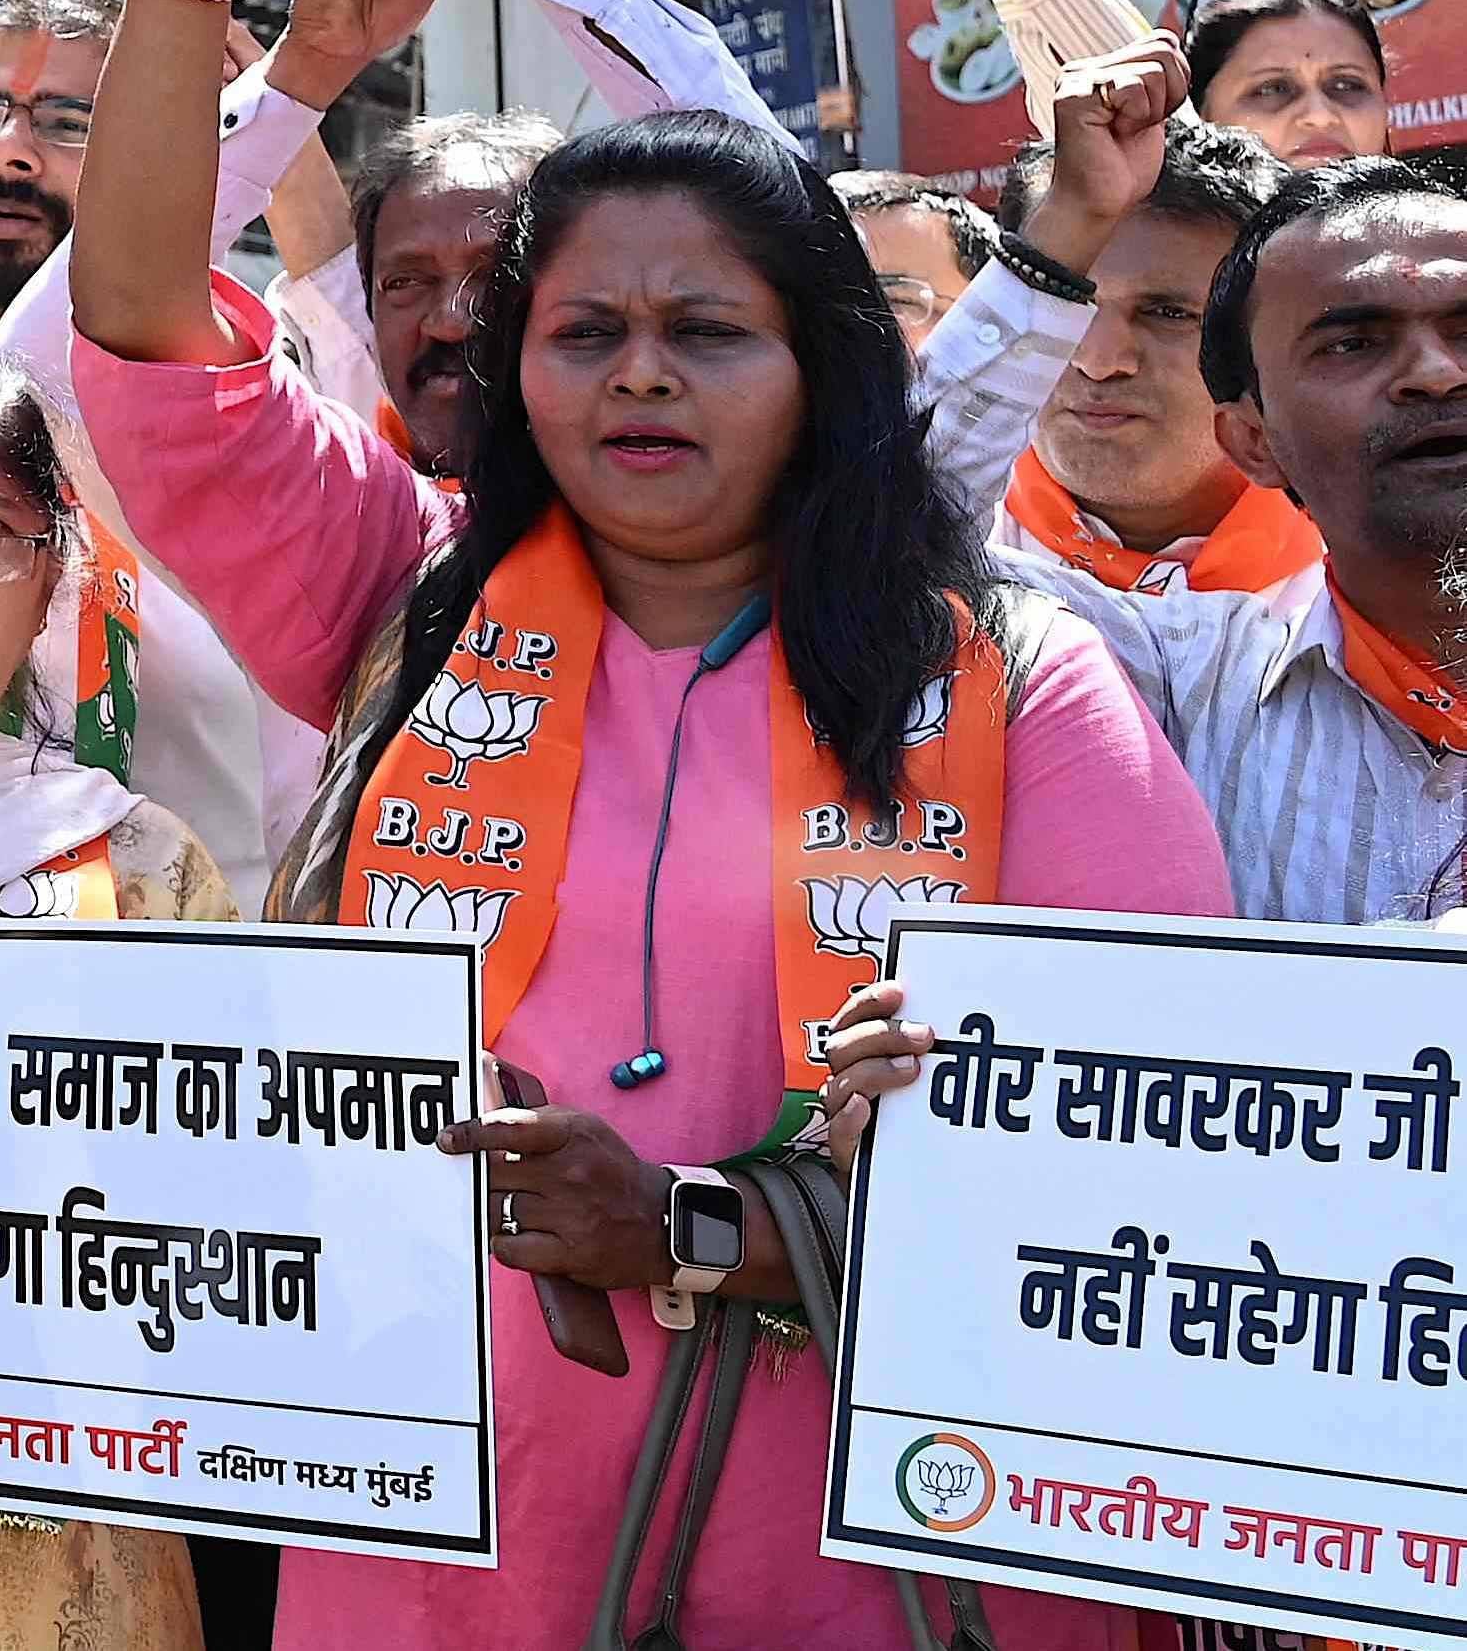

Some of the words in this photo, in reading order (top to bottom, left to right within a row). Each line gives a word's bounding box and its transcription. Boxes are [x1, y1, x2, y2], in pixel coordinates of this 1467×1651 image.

[454, 620, 559, 680] .J.P.
[373, 796, 527, 871] B.J.P.
[800, 798, 968, 861] B.J.P.
[5, 1034, 164, 1136] समाज
[169, 1044, 239, 1140] का
[255, 1049, 460, 1152] अपमान
[926, 1011, 1048, 1135] वीर
[1053, 1045, 1341, 1150] सावरकर
[1362, 1045, 1462, 1176] जी
[56, 1186, 322, 1353] हिन्दुस्थान
[1014, 1224, 1173, 1353] नहीं
[1164, 1239, 1369, 1380] सहेगा
[1379, 1256, 1467, 1388] हि
[85, 1415, 189, 1479] पार्टी
[198, 1443, 288, 1487] दक्षिण
[293, 1455, 358, 1492] मध्य
[363, 1451, 435, 1508] मुंबई
[1004, 1471, 1210, 1556] भारतीय
[1222, 1505, 1384, 1575] जनता
